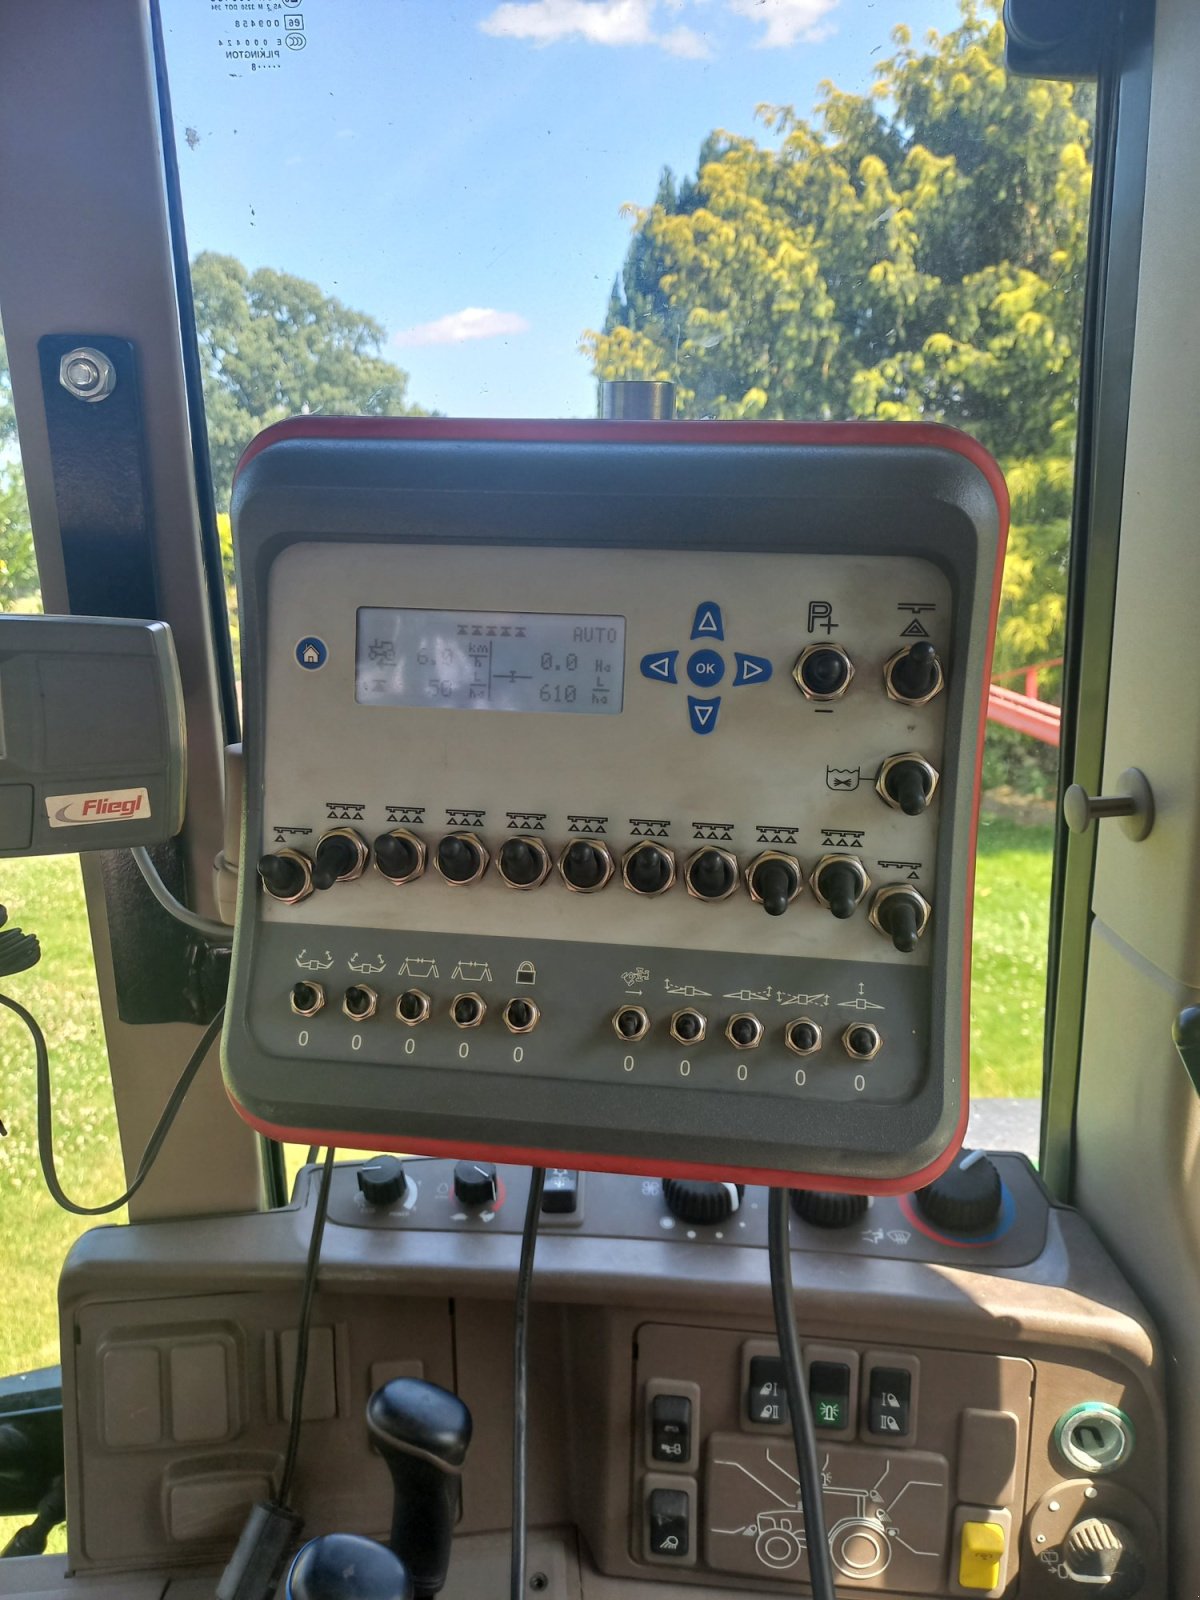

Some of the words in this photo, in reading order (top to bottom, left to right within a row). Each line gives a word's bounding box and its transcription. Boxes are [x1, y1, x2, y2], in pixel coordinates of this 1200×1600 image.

[573, 626, 617, 643] AUTO
[540, 652, 578, 671] 0.0
[695, 663, 716, 674] OK
[539, 684, 577, 703] 610
[82, 795, 142, 816] Fliegl
[298, 1031, 309, 1047] 0
[351, 1034, 362, 1050] 0
[404, 1038, 416, 1054] 0
[458, 1042, 469, 1058] 0
[513, 1046, 524, 1063] 0
[623, 1056, 635, 1072] 0
[680, 1060, 691, 1076] 0
[737, 1064, 748, 1081] 0
[795, 1069, 806, 1086] 0
[854, 1074, 866, 1091] 0
